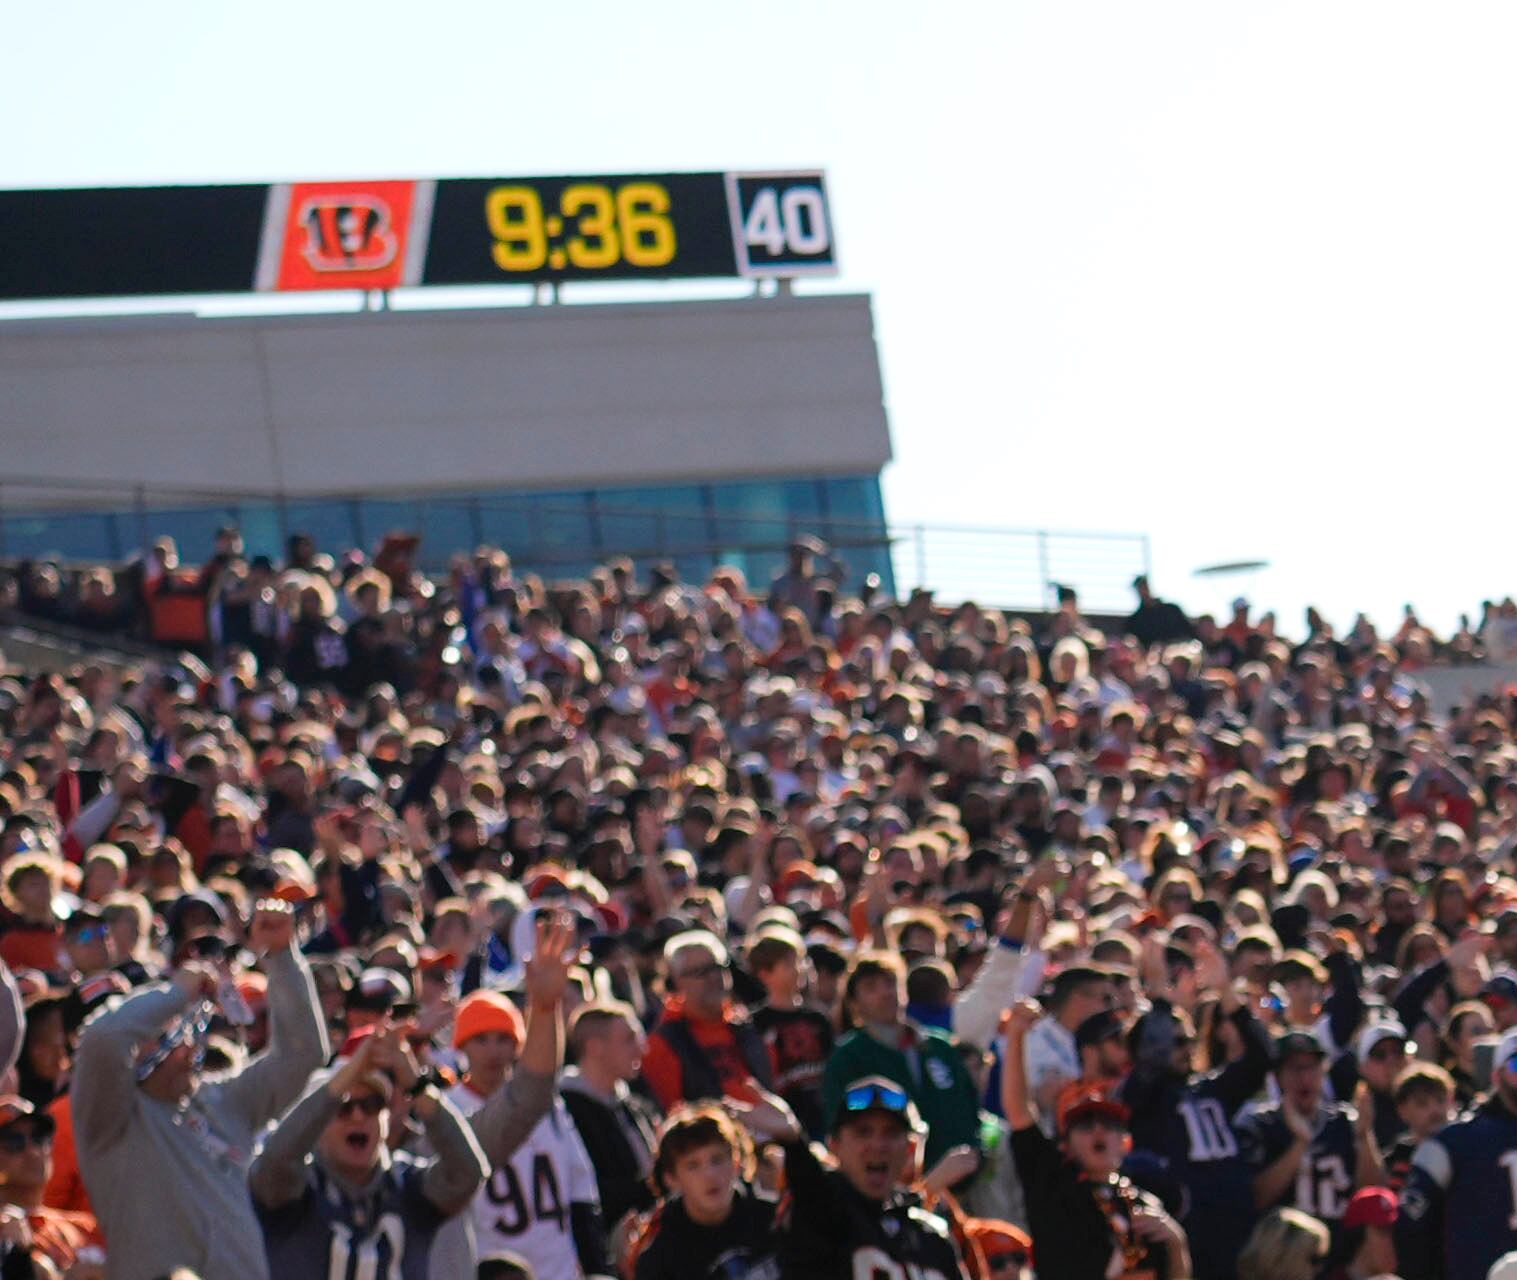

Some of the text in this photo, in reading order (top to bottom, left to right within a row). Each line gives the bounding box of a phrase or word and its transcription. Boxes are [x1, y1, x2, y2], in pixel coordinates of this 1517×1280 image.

[485, 183, 677, 271] 9:36
[745, 187, 827, 255] 40
[1177, 1098, 1238, 1163] 10
[487, 1154, 567, 1236] 94
